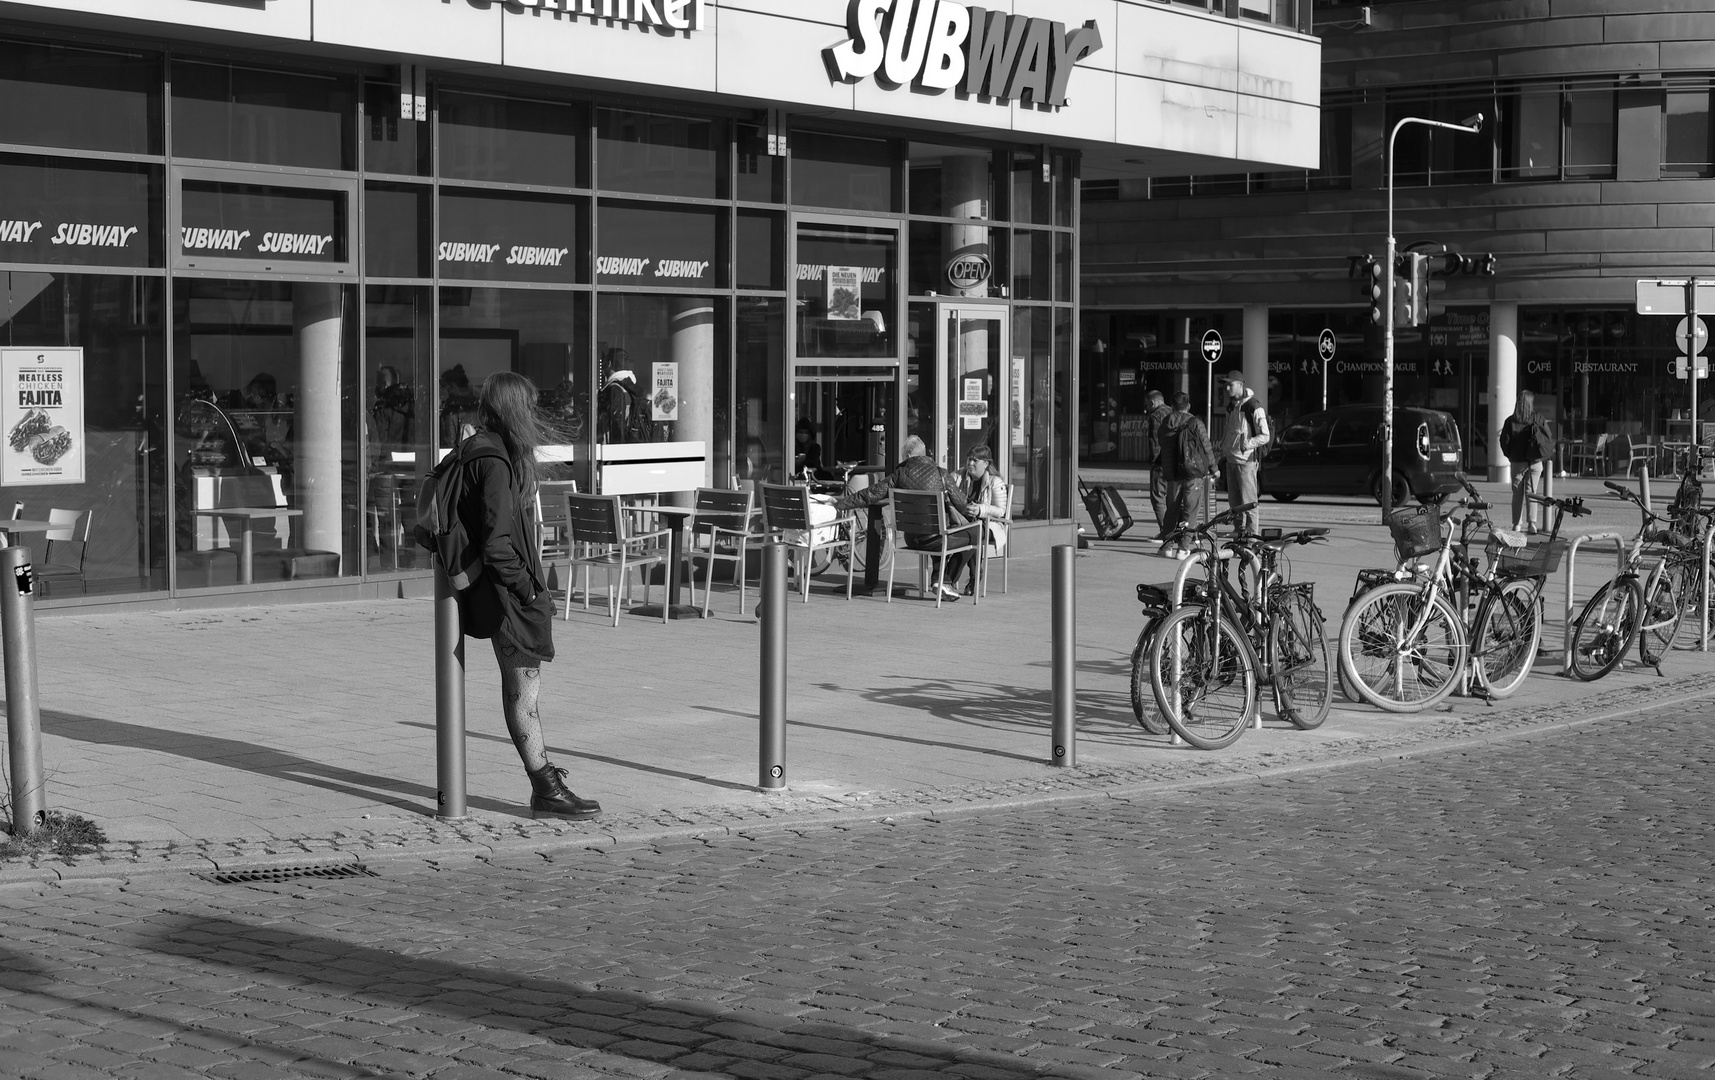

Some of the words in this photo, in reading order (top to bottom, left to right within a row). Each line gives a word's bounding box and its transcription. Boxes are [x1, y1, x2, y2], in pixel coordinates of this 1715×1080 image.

[821, 0, 1103, 108] SUBWAY
[51, 222, 138, 247] SUBWAY
[182, 227, 251, 250] UBWAY
[258, 232, 333, 255] SUBWAY
[438, 242, 500, 262] SUBWAY
[506, 246, 568, 266] SUBWAY
[597, 256, 650, 275] SUBWAY
[654, 260, 709, 278] SUBWAY
[954, 262, 986, 279] OPEN
[1447, 312, 1476, 325] Time
[19, 374, 62, 382] MEATLESS
[19, 382, 62, 390] CHICKEN
[19, 390, 62, 406] FAJITA
[872, 424, 885, 432] 485
